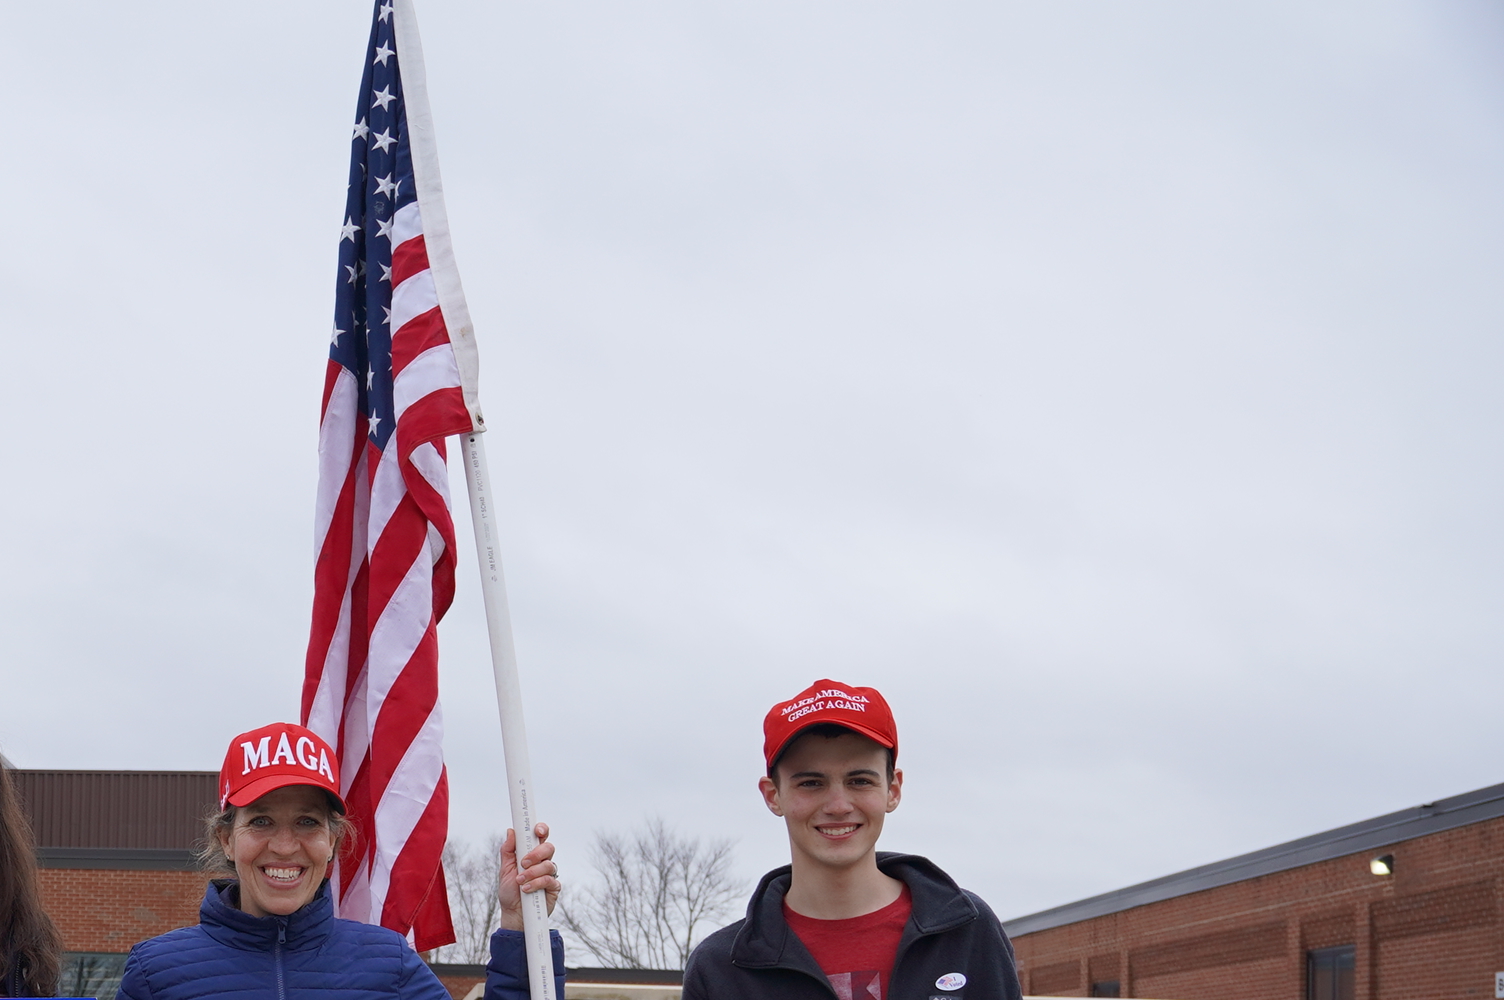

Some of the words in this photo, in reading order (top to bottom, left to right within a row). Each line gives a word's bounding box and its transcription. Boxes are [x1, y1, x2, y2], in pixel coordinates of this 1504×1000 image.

[780, 697, 815, 716] MAKE
[814, 689, 870, 704] AMERICA
[787, 701, 826, 722] GREAT
[825, 699, 866, 713] AGAIN
[240, 732, 335, 783] MAGA
[520, 789, 529, 810] America
